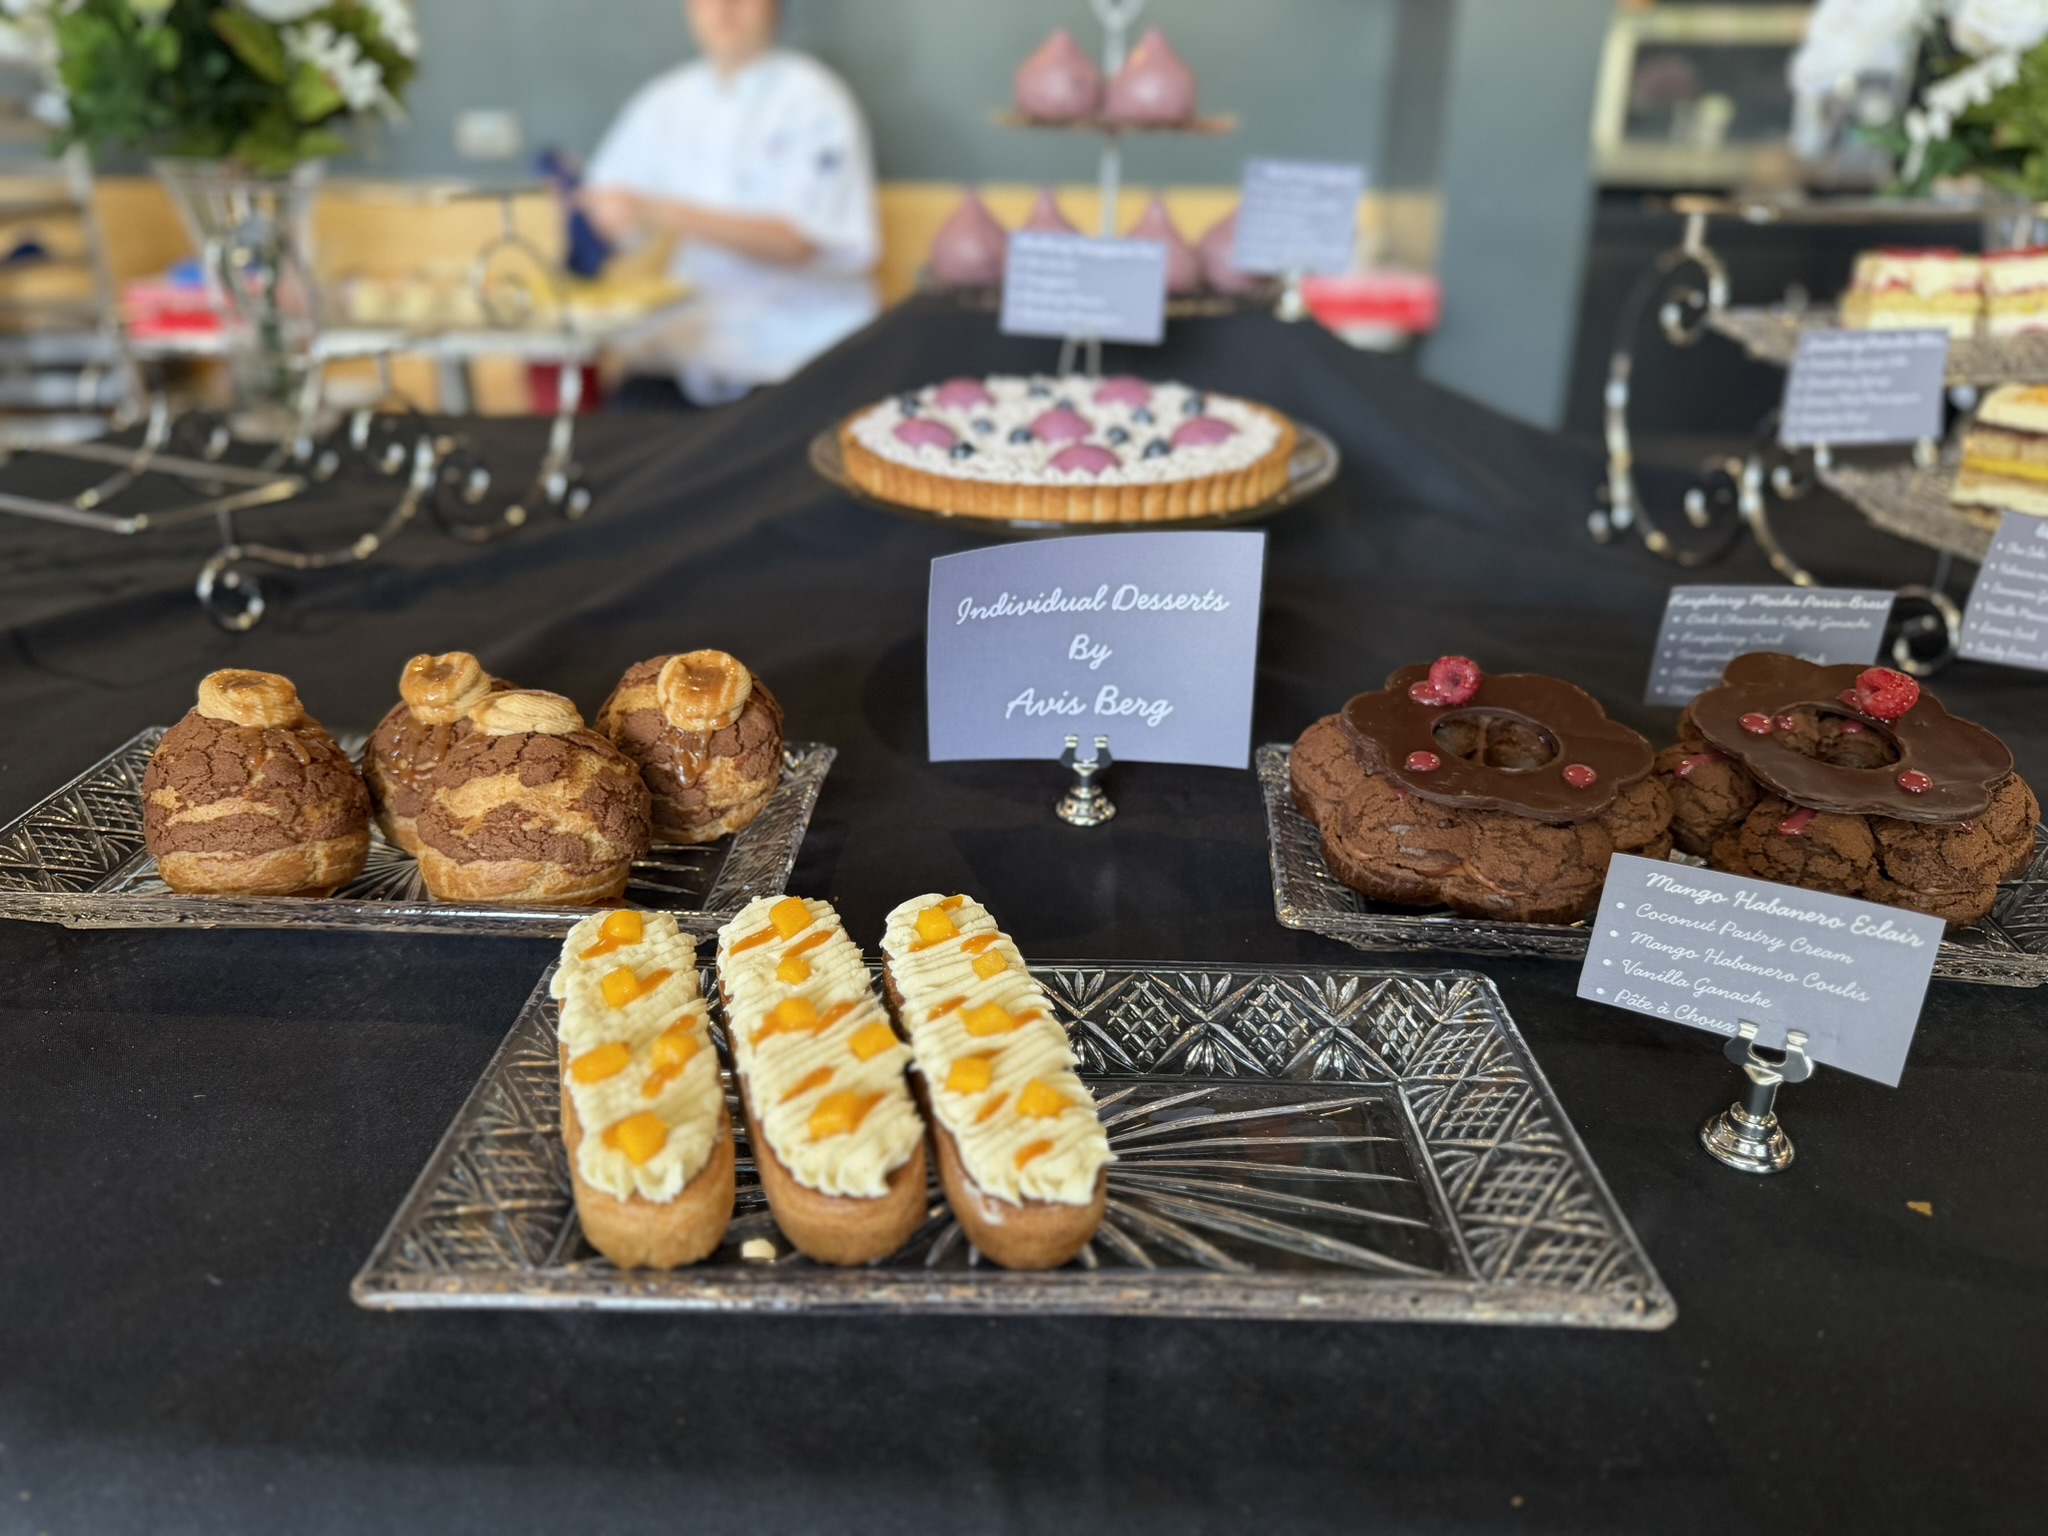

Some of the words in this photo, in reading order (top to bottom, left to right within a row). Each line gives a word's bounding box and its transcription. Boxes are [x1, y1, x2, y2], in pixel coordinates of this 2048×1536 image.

[956, 584, 1108, 625] Individual
[1111, 584, 1230, 611] Desserts
[1068, 633, 1112, 670] By
[1005, 688, 1087, 720] Avis
[1094, 684, 1174, 727] Berg
[1646, 872, 1728, 905] Mango
[1734, 890, 1844, 929] Habanero
[1850, 915, 1925, 948] Eclair
[1636, 903, 1717, 932] Coconut
[1719, 921, 1785, 952] Pastry
[1789, 937, 1855, 965] Cream
[1622, 959, 1690, 988] Vanilla
[1692, 977, 1772, 1008] Ganache
[1631, 931, 1699, 960] Mango
[1704, 948, 1799, 983] Habanero
[1802, 972, 1871, 1002] Coulis
[1614, 988, 1654, 1010] Pâte
[1656, 1001, 1670, 1014] à
[1674, 1004, 1737, 1032] Choux
